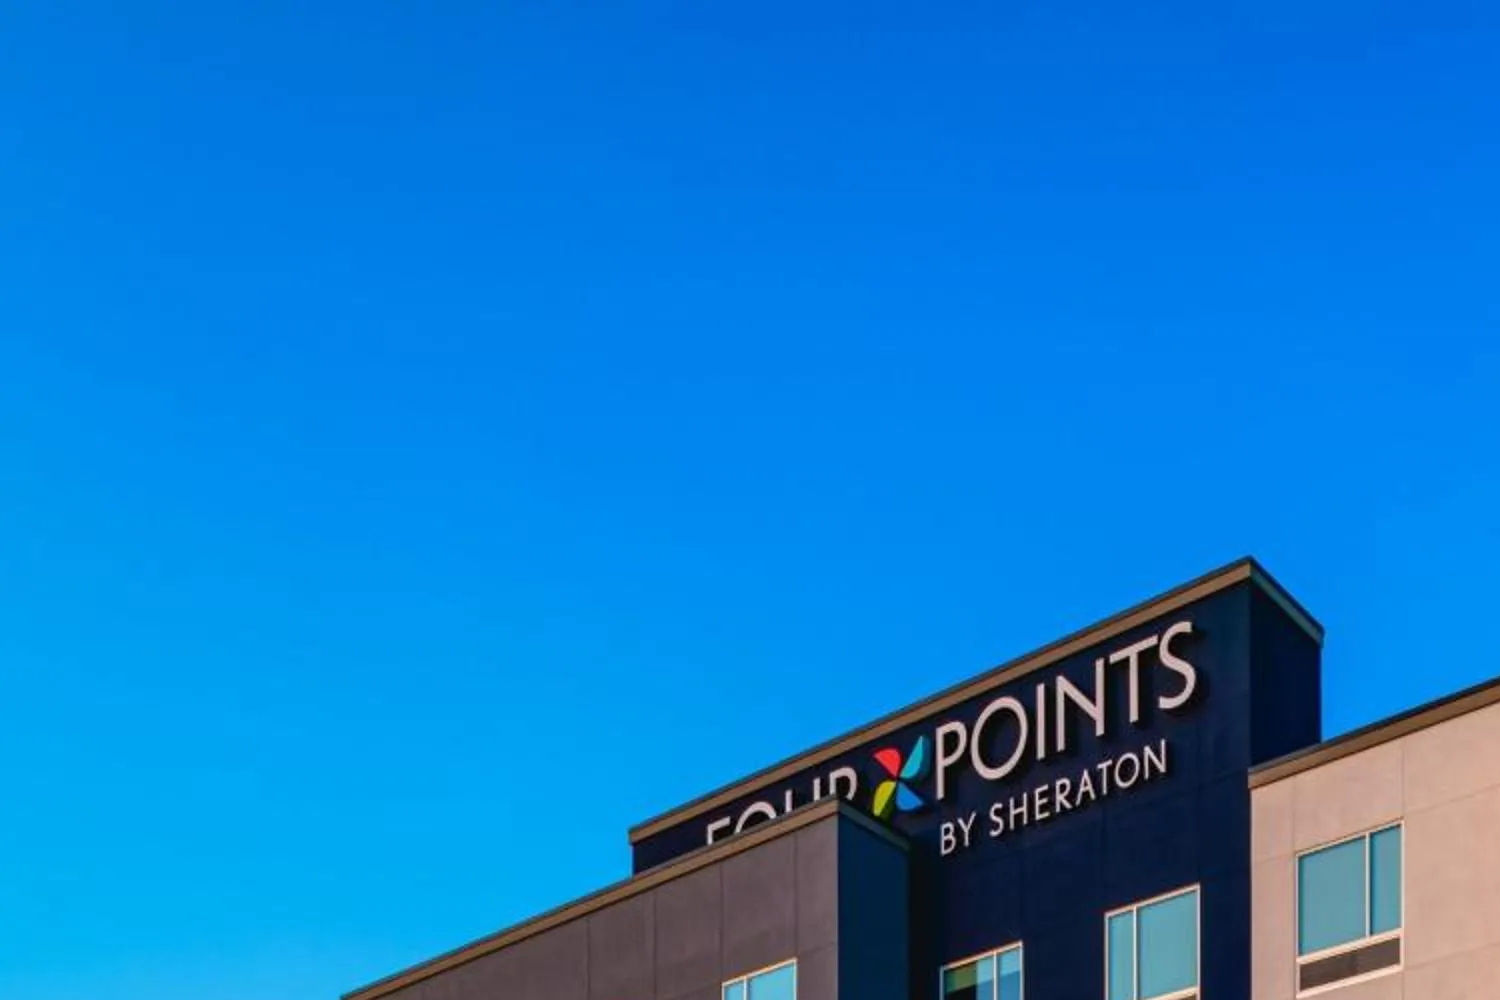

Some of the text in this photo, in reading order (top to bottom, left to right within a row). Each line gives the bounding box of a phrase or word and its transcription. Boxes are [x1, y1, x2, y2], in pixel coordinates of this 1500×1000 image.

[935, 621, 1197, 800] POINTS
[940, 738, 1167, 856] BY SHERATON
